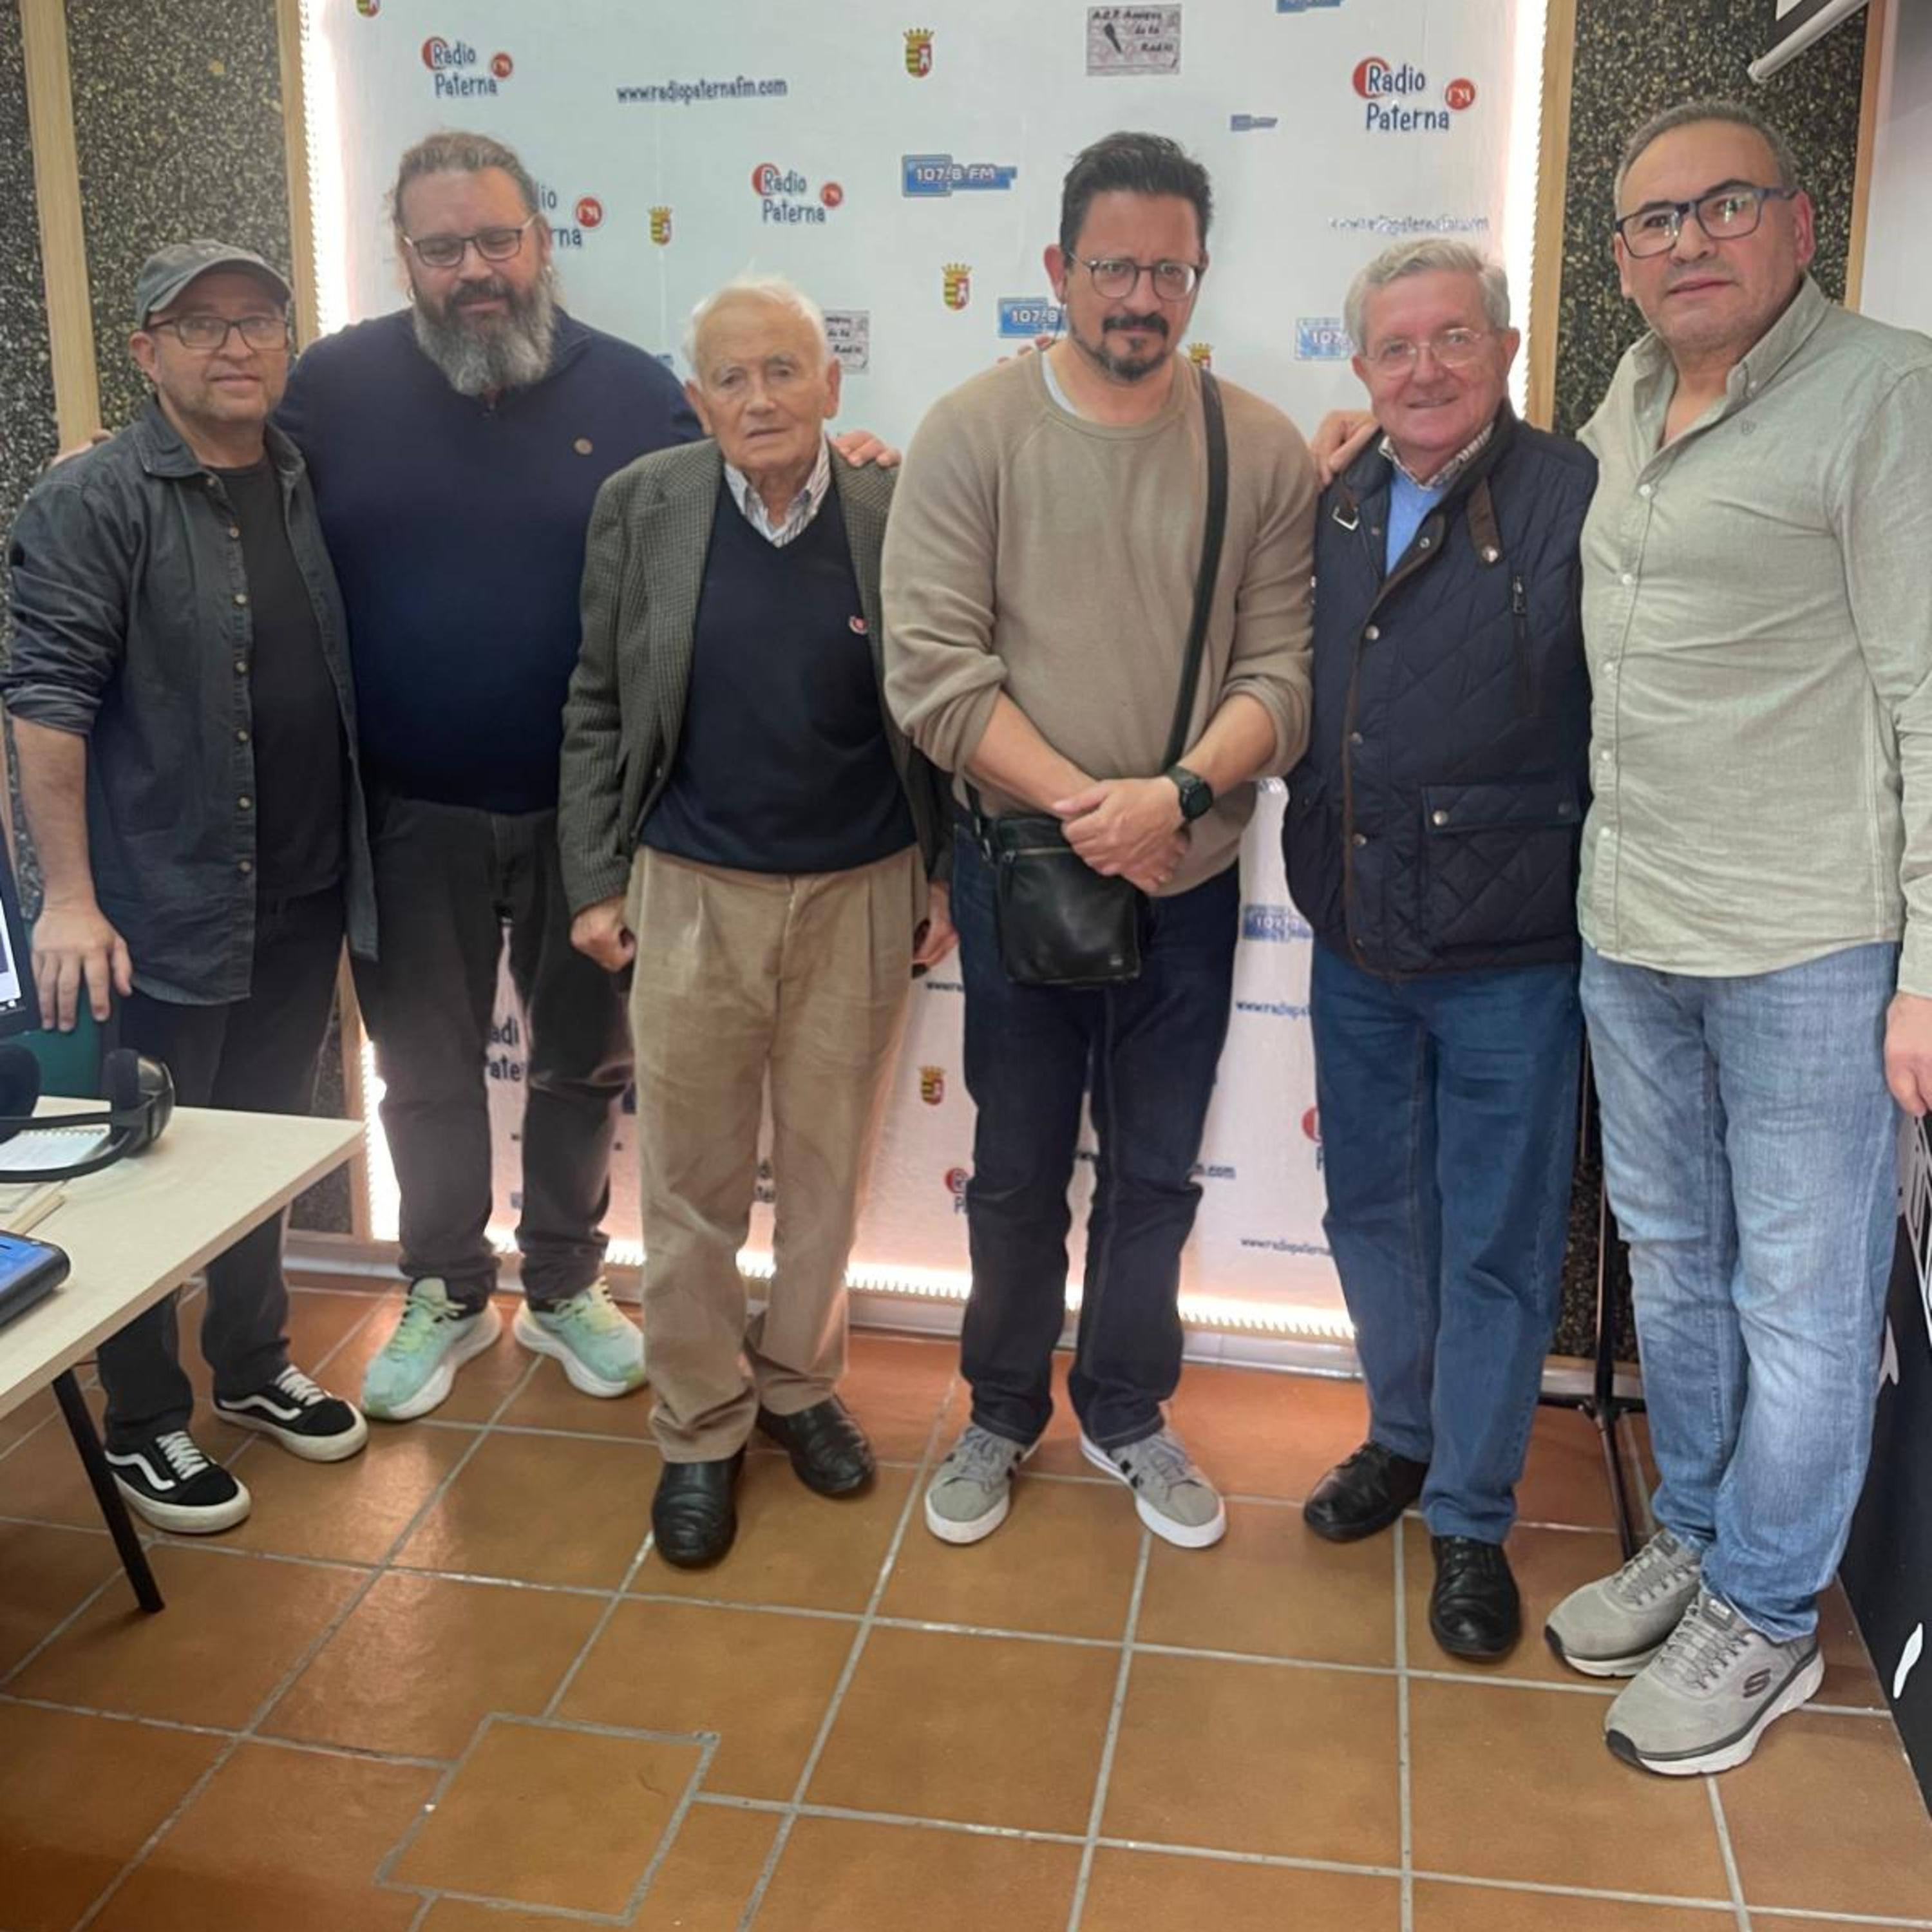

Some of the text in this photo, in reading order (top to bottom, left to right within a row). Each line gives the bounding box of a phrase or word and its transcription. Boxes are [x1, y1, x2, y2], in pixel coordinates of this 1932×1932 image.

[435, 73, 497, 97] Paterna
[1367, 64, 1426, 95] Radio
[1366, 102, 1450, 130] Paterna
[764, 169, 807, 196] Radio
[969, 166, 996, 180] FM
[762, 198, 826, 223] Paterna
